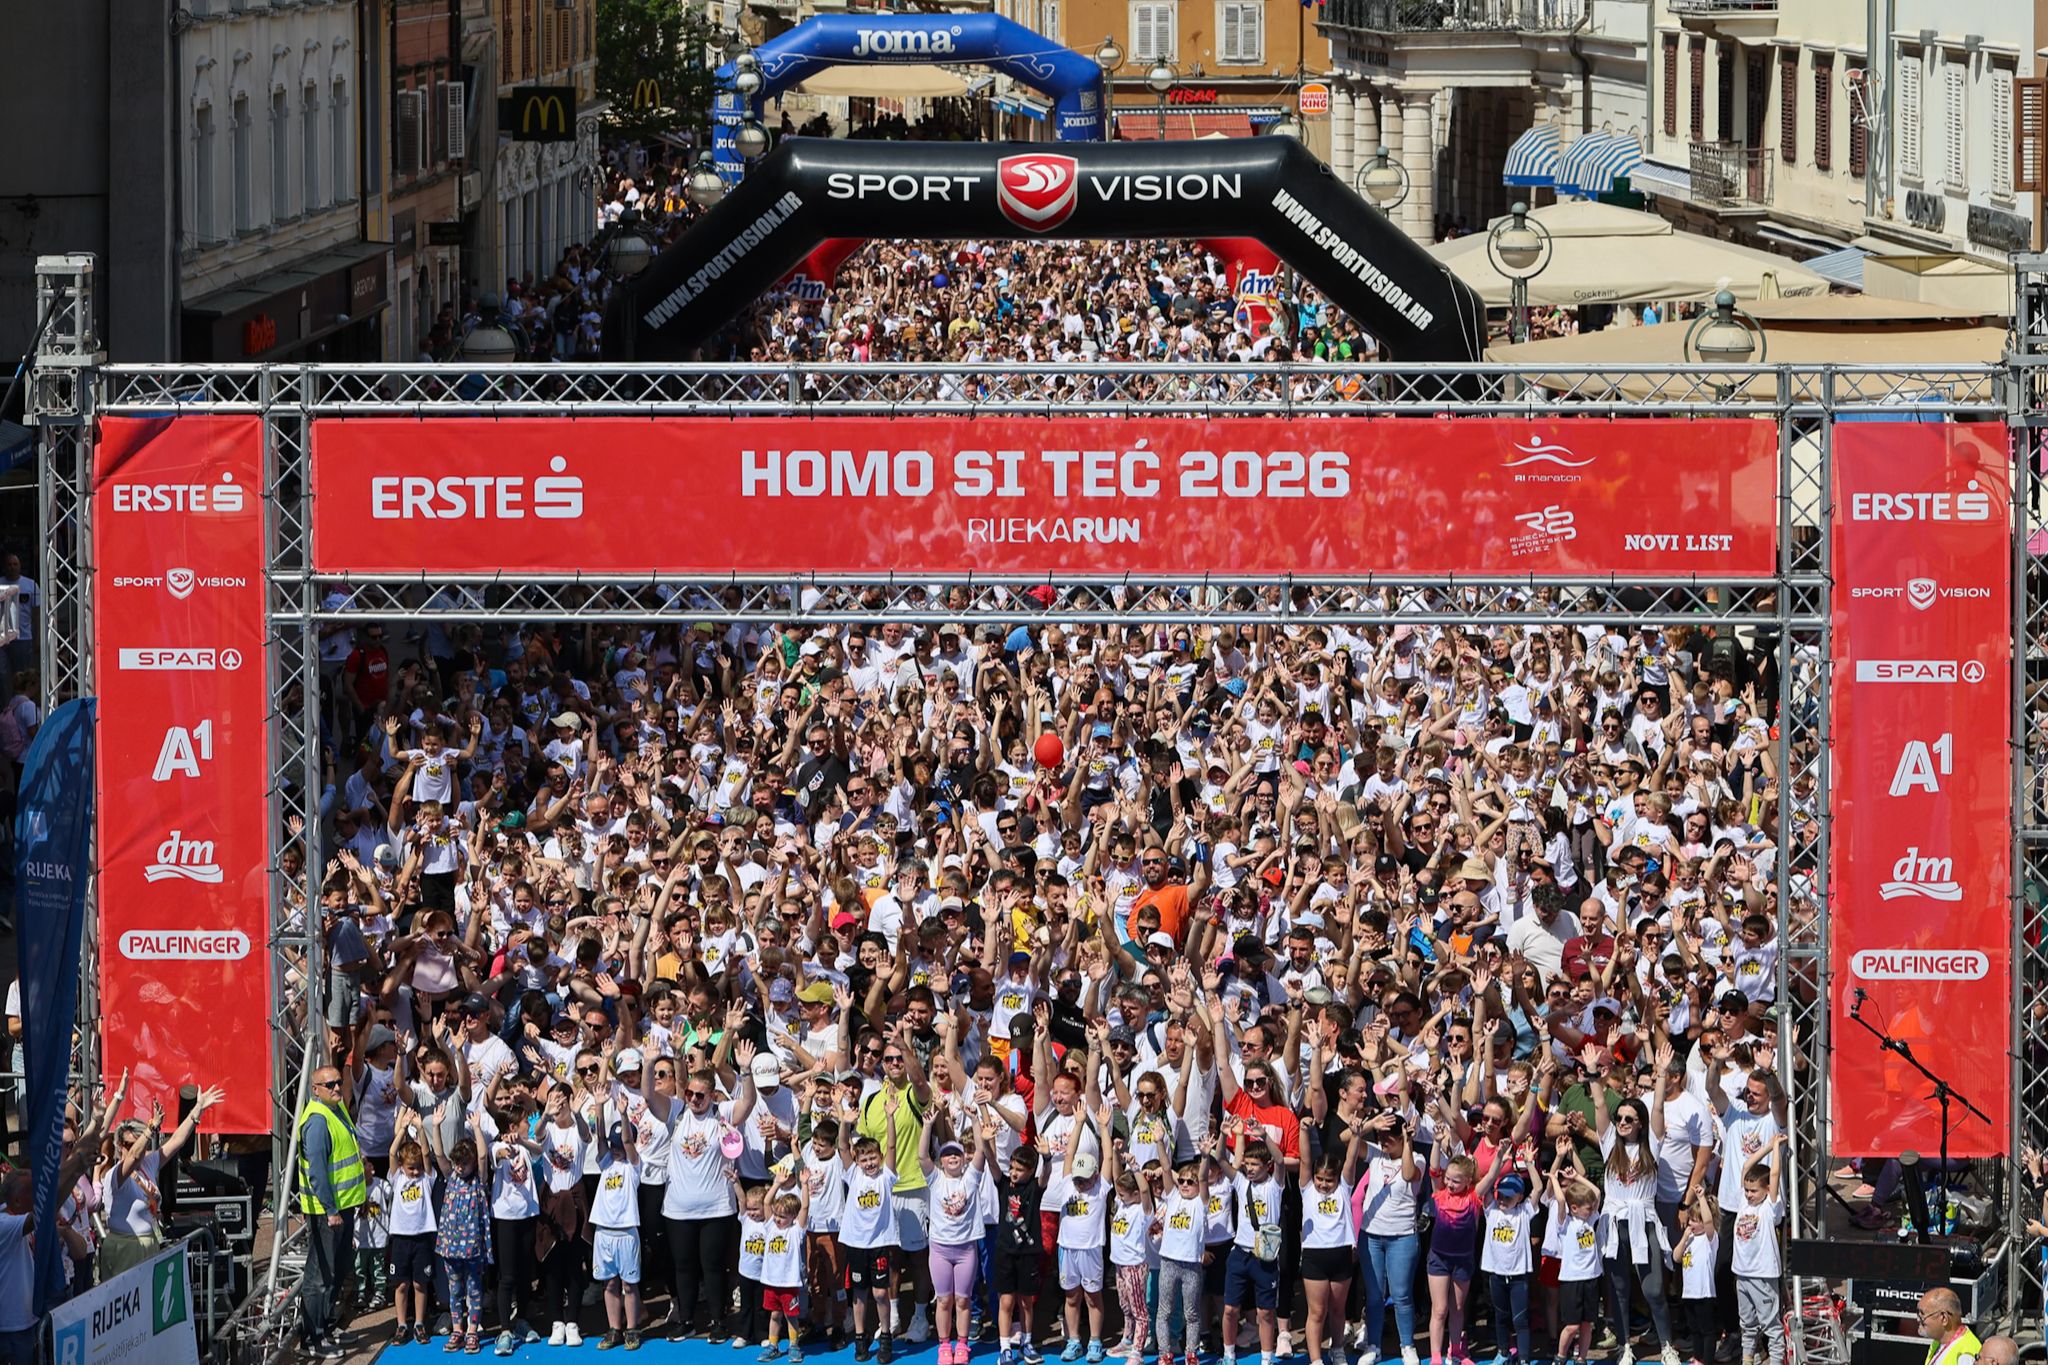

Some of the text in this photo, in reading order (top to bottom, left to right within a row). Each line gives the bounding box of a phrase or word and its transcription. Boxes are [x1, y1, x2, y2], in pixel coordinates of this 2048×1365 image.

[1169, 89, 1217, 103] TISAK
[1302, 100, 1327, 108] KING
[826, 173, 1242, 201] SPORT VISION
[643, 190, 803, 330] WWW.SPORTVISION.HR
[1271, 187, 1434, 331] WWW.SPORTVISION.HR
[787, 273, 825, 299] dm
[741, 439, 1350, 498] HOMO SI TEĆ 2026
[1528, 474, 1581, 482] maraton
[113, 484, 207, 512] ERSTE
[372, 476, 525, 518] ERSTE
[1852, 493, 1951, 521] ERSTE
[967, 517, 1141, 543] RIJEKARUN
[1511, 536, 1564, 549] SPORTSKI
[1625, 534, 1733, 551] NOVI LIST
[1512, 544, 1550, 556] SAVEZ
[113, 577, 246, 587] SPORT VISION
[1851, 587, 1991, 598] SPORT VISION
[138, 652, 213, 666] SPAR
[1876, 664, 1955, 678] SPAR
[152, 719, 213, 782] A1
[1889, 733, 1953, 797] A1
[157, 830, 214, 864] dm
[26, 861, 72, 881] RIJEKA
[1893, 847, 1953, 881] dm
[129, 936, 241, 954] PALFINGER
[1862, 955, 1979, 973] PALFINGER
[93, 1286, 141, 1340] RIJEKA
